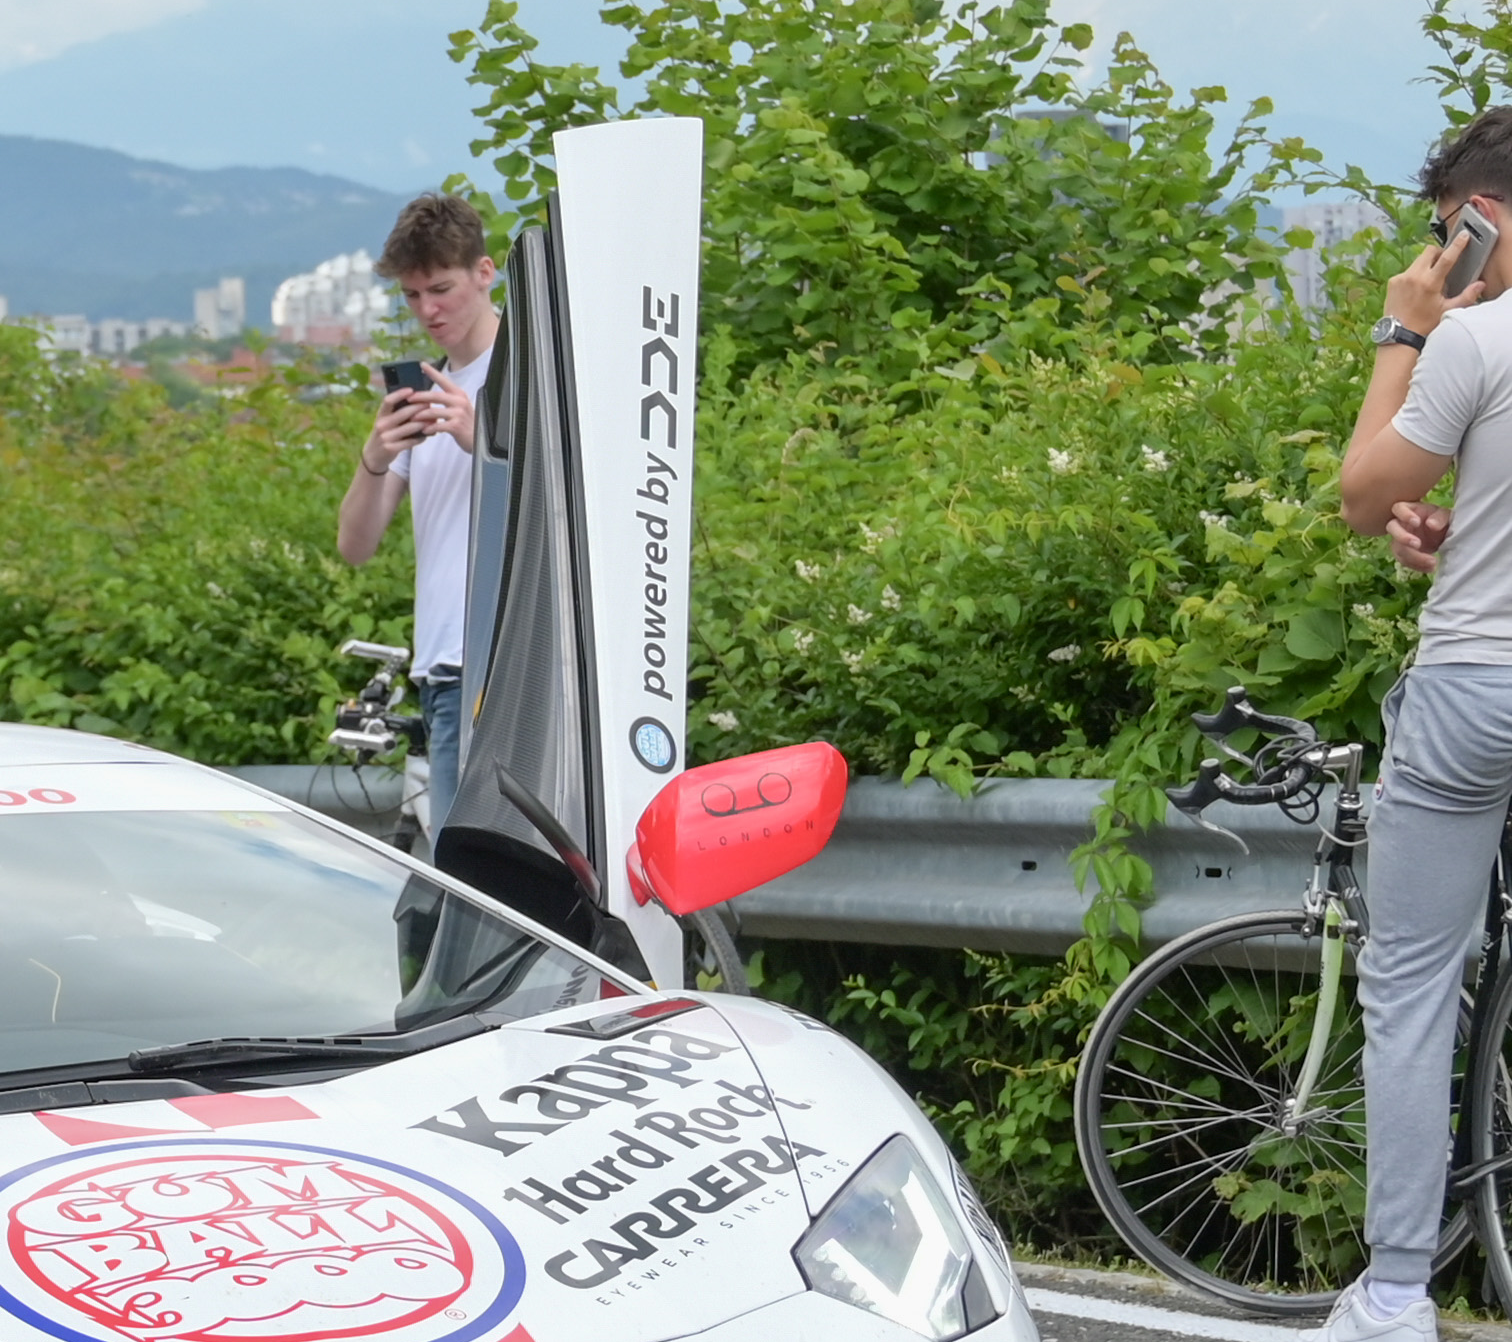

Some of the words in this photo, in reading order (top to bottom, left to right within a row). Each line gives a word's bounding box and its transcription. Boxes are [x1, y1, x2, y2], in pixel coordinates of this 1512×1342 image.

[640, 284, 680, 451] DDE
[636, 451, 679, 507] by
[634, 509, 673, 702] powered
[697, 819, 814, 852] LONDON
[406, 1029, 742, 1158] Kappa
[502, 1129, 675, 1225] Hard
[634, 1079, 812, 1149] Rock
[544, 1134, 829, 1290] CARRERA
[595, 1237, 710, 1306] EYEWEAR
[719, 1188, 791, 1229] SINCE
[802, 1157, 851, 1187] 1956
